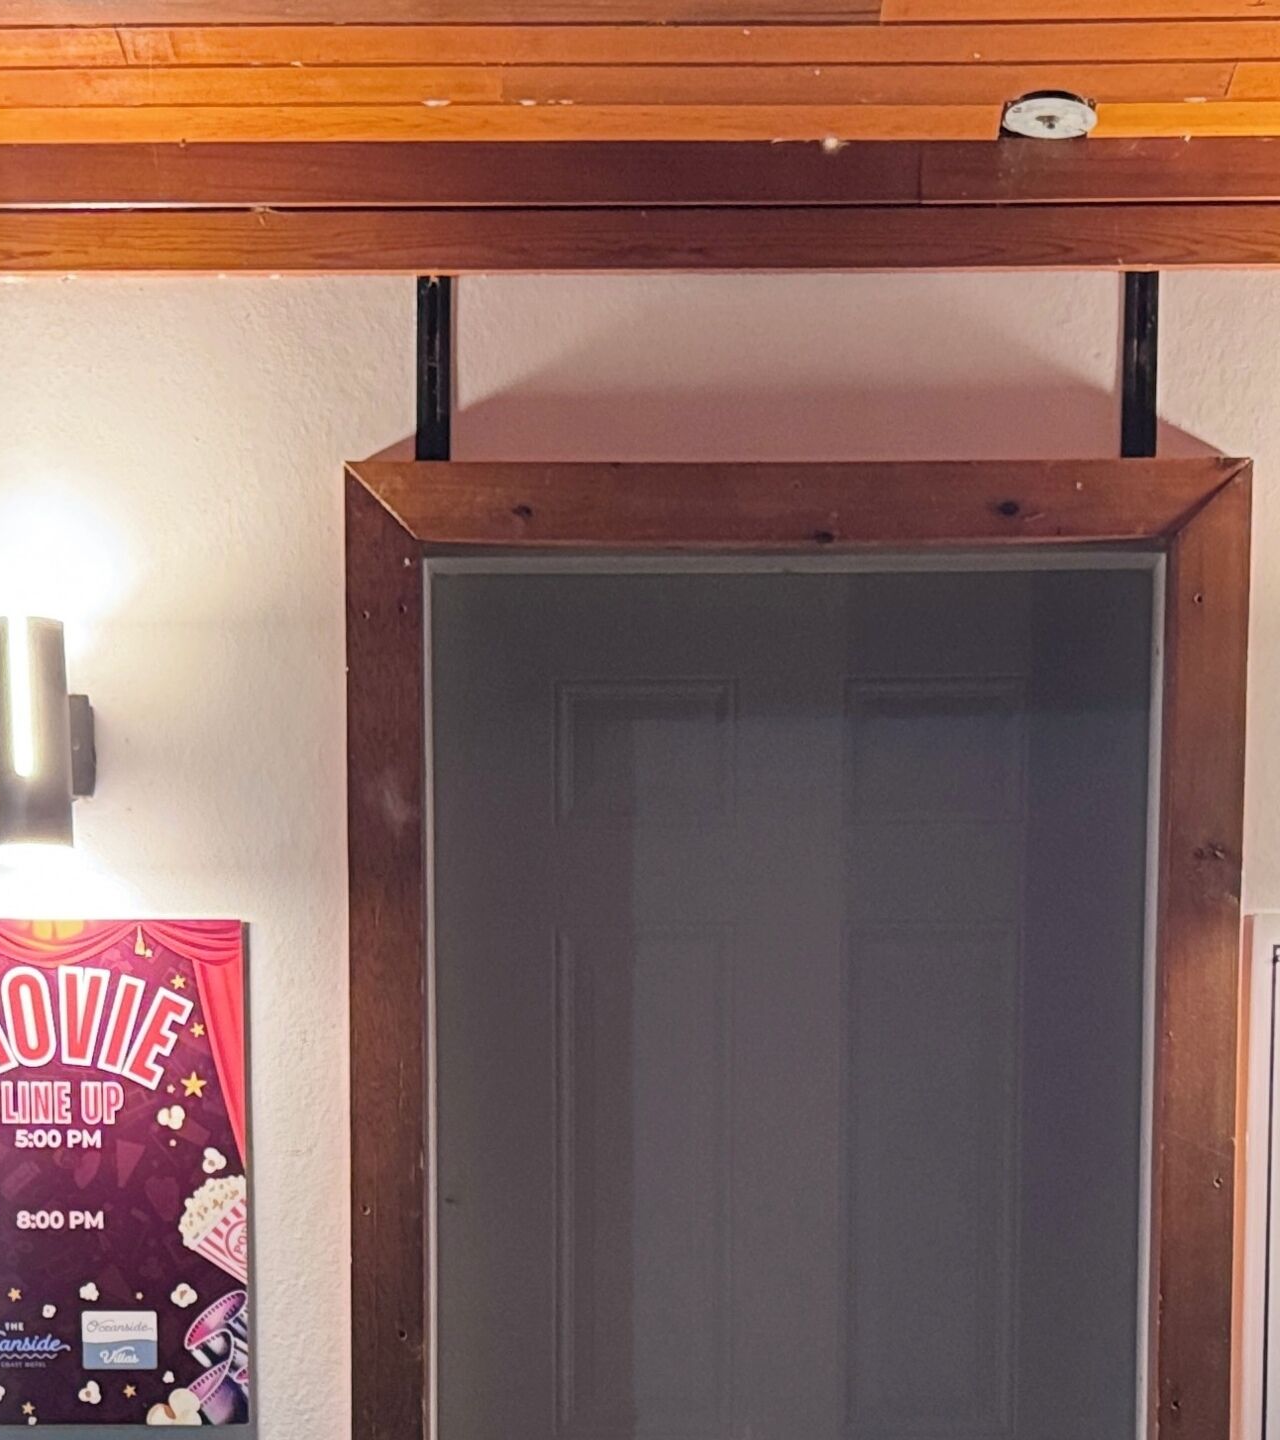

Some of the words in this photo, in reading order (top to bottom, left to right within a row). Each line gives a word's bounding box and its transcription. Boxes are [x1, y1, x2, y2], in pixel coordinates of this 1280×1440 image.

[0, 1080, 72, 1125] LINE
[80, 1080, 125, 1125] UP
[14, 1129, 62, 1149] 5:00
[66, 1129, 102, 1149] PM
[16, 1209, 65, 1230] 8:00
[68, 1209, 105, 1230] PM
[4, 1322, 25, 1331] THE
[86, 1319, 154, 1333] Oceanside
[99, 1346, 140, 1364] Villas
